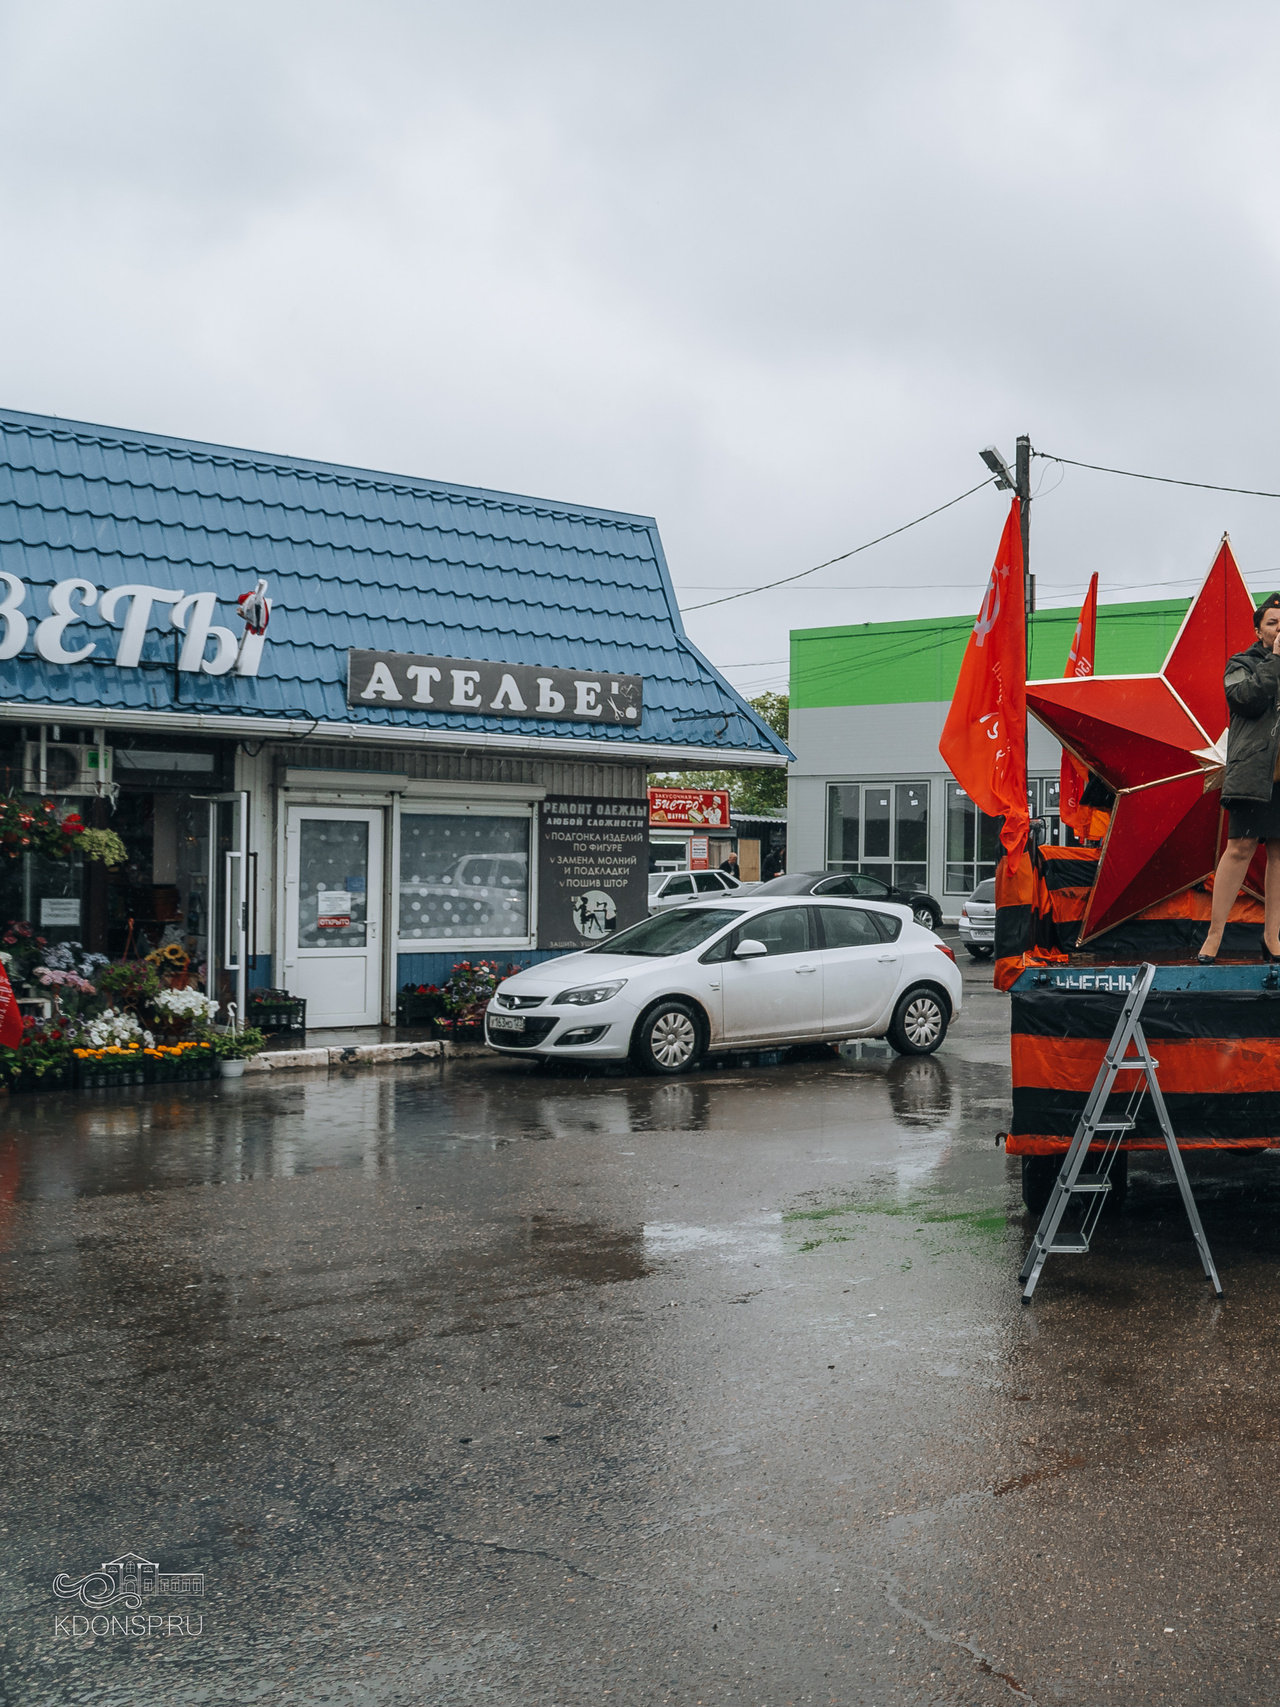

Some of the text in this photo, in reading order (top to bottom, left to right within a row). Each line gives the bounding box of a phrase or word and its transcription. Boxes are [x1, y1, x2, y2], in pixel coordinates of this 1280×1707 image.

[361, 661, 603, 717] АТЕЛЬЕ
[543, 802, 647, 817] РЕМОНТ ОДЕЖДЫ
[652, 798, 699, 811] БИСТРО
[546, 817, 644, 828] ЛЮБОЙ СЛОЖНОСТИ
[551, 831, 643, 843] ПОДГОНКА ИЗДЕЛИЙ
[573, 843, 622, 853] ПО ФИГУРЕ
[557, 855, 637, 866] ЗАМЕНА МОЛНИЙ
[564, 866, 630, 876] И ПОДКЛАДКИ
[566, 878, 629, 888] ПОШИВ ШТОР
[319, 918, 350, 926] ОТКРЫТО
[1056, 974, 1142, 991] УЧЕБНЫ
